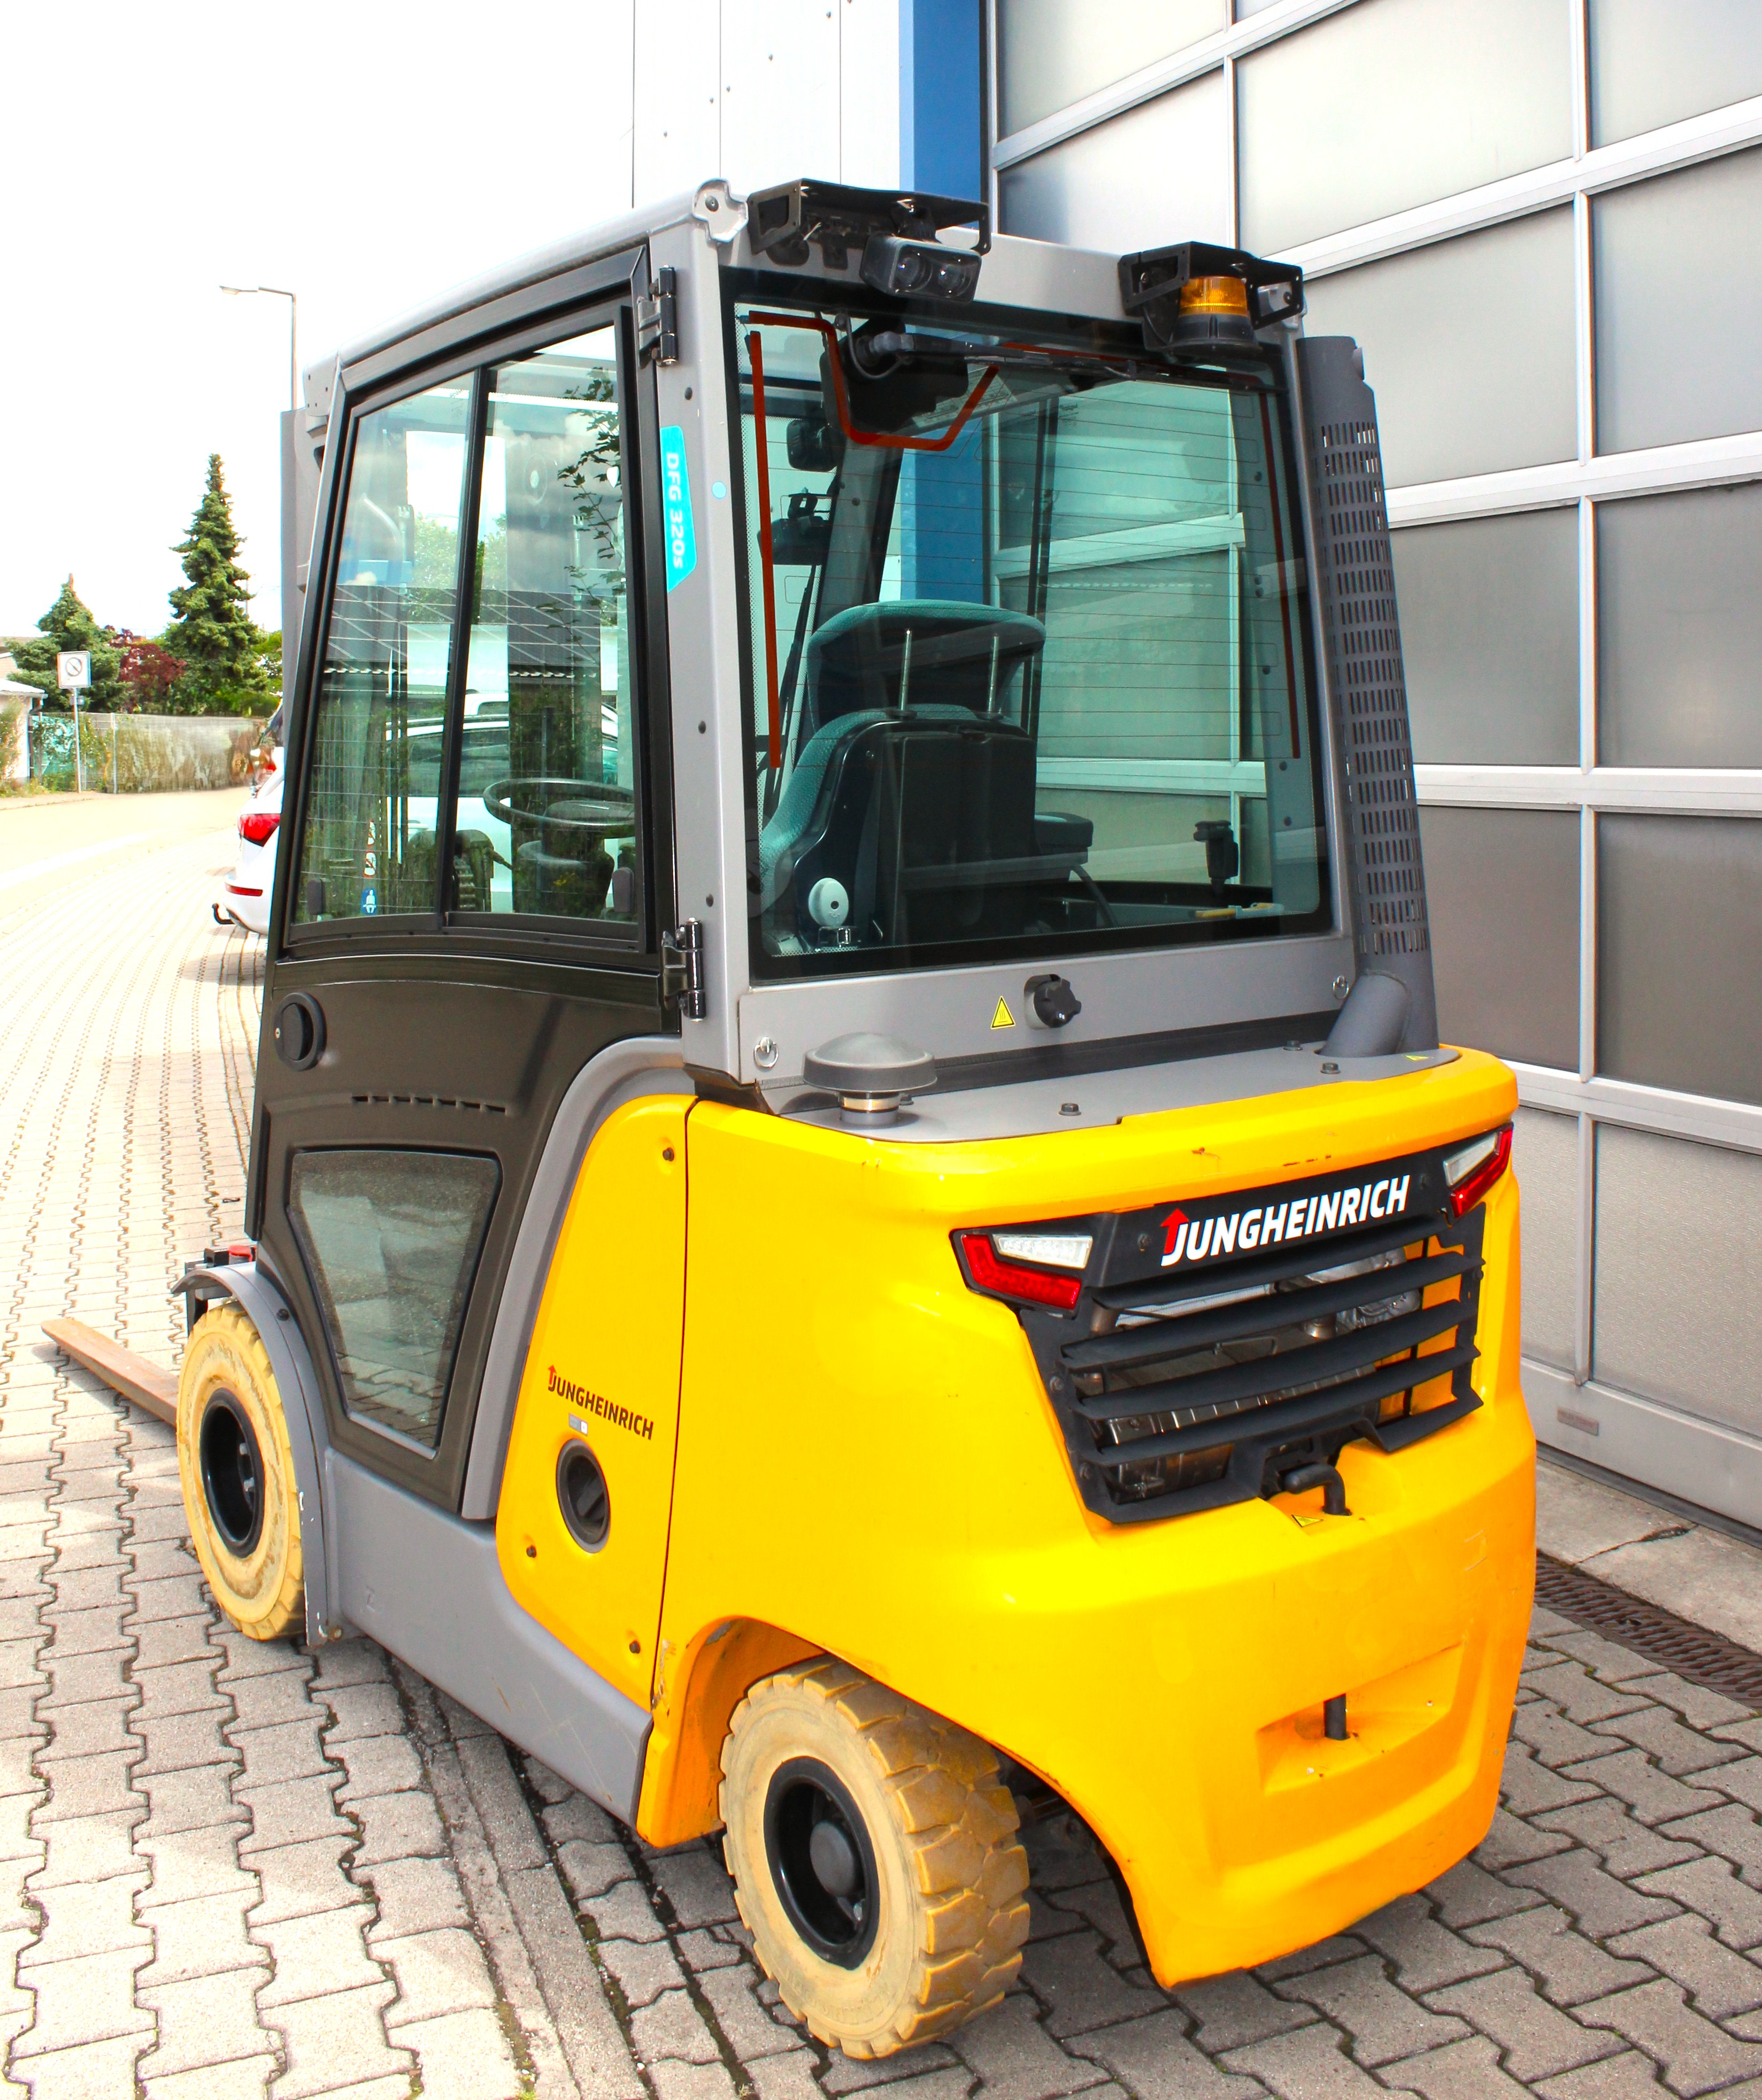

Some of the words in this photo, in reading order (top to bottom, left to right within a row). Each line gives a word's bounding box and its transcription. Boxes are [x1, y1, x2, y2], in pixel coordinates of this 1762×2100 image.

[667, 453, 681, 501] DFG
[1161, 1175, 1410, 1267] JUNGHEINRICH
[548, 1374, 653, 1440] JUNGHEINRICH
